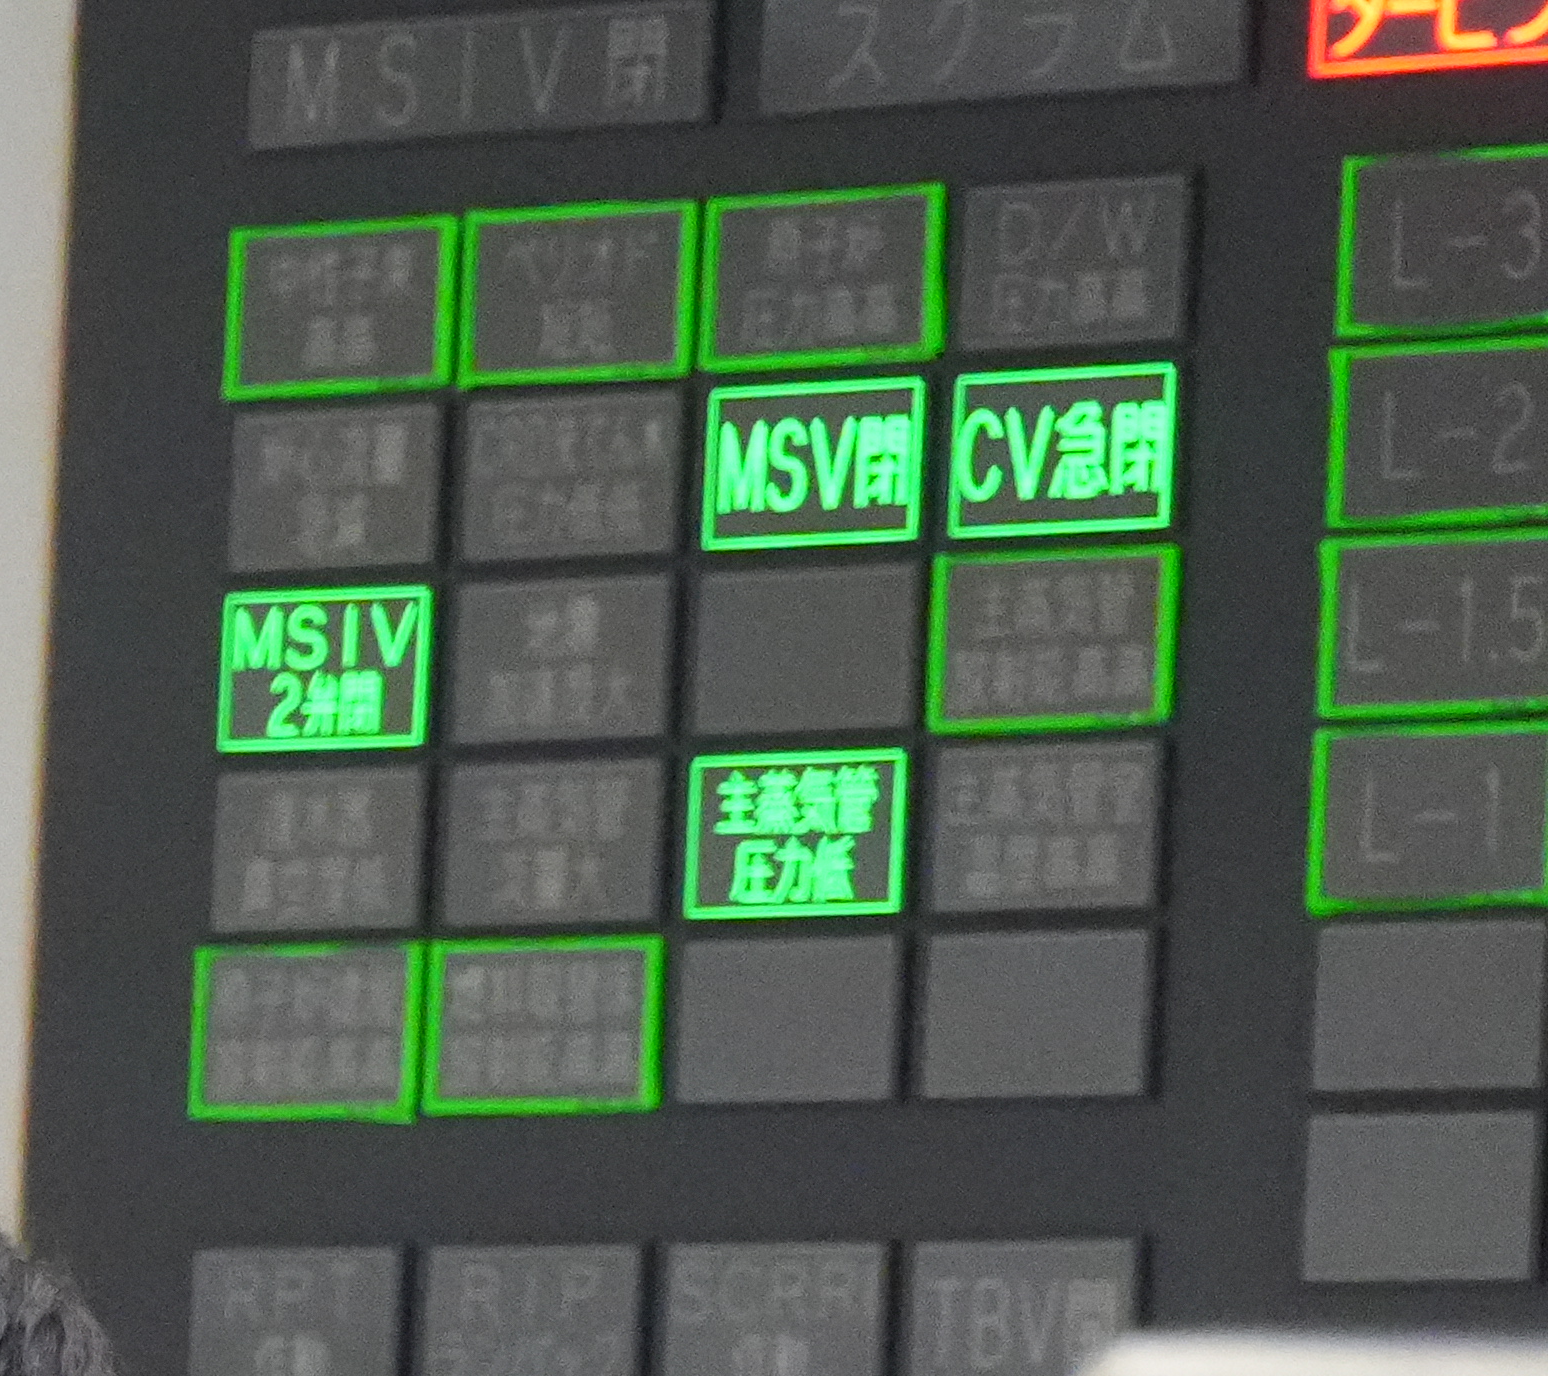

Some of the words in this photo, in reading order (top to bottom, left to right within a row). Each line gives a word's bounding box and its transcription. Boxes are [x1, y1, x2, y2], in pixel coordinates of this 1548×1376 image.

[998, 196, 1158, 268] D/W
[1391, 189, 1542, 291] L-3
[716, 414, 912, 514] MSV閉
[956, 400, 1168, 502] CV急閉
[1381, 381, 1534, 480] L-2
[232, 602, 418, 672] MSIV
[712, 765, 880, 836] 主蒸気管
[1360, 765, 1501, 864] L-1
